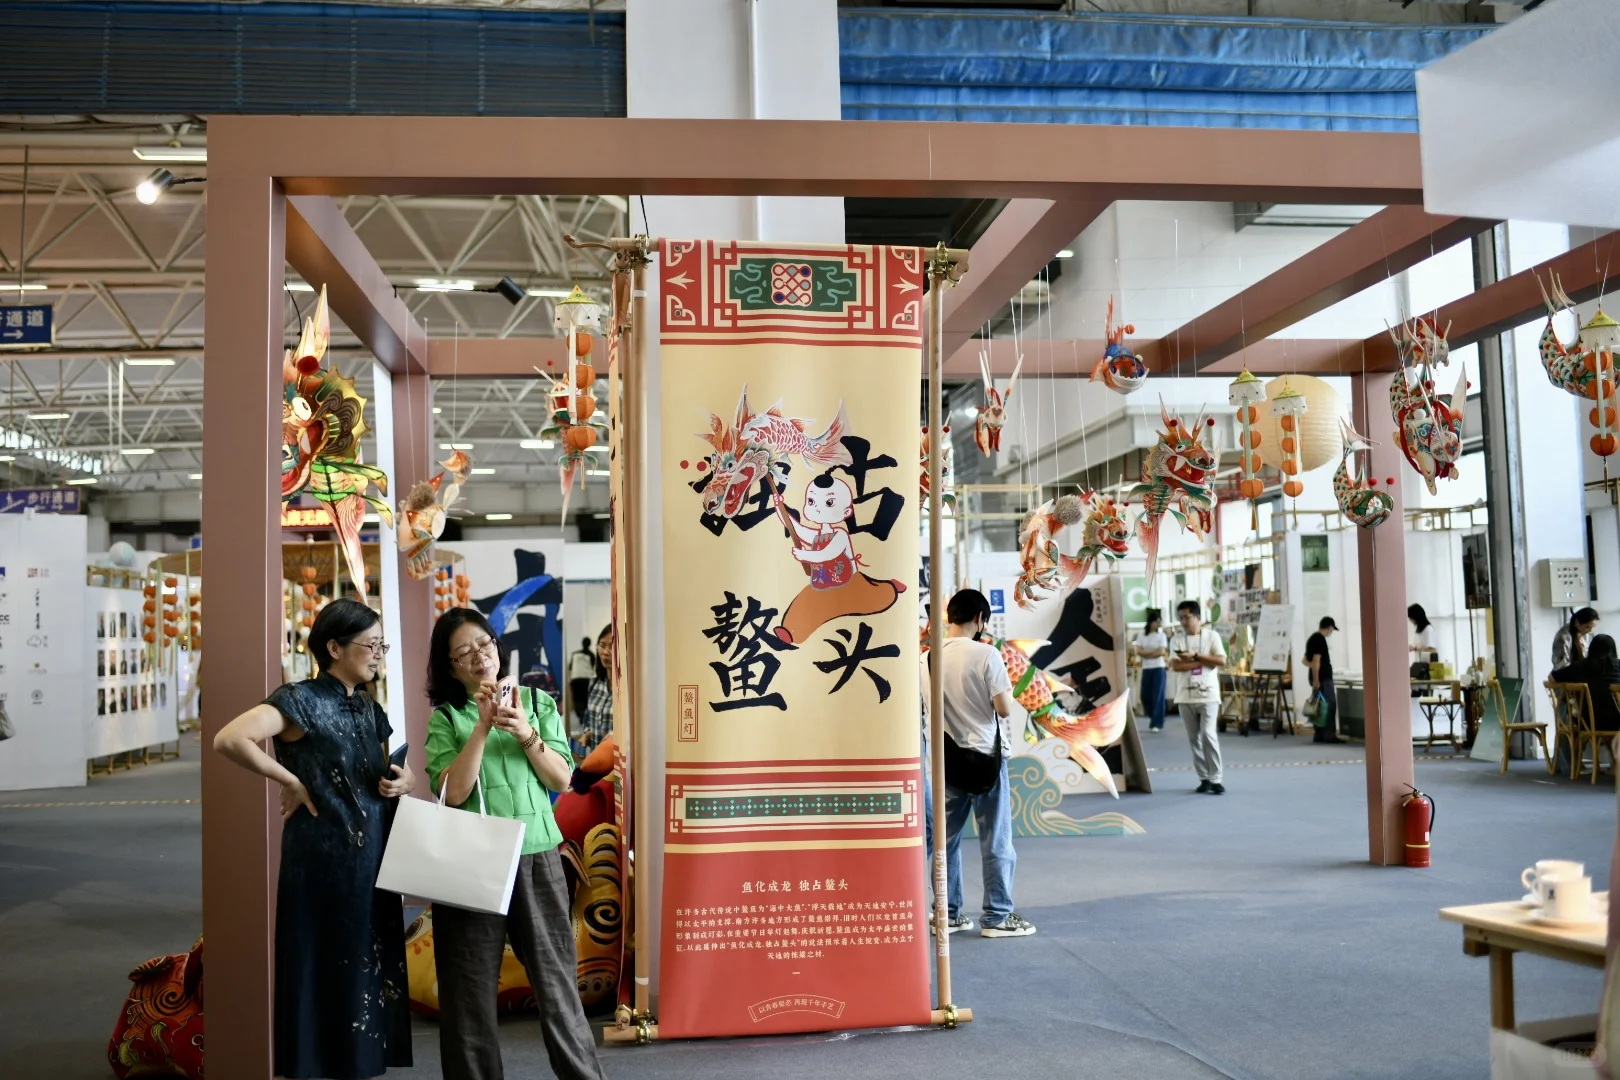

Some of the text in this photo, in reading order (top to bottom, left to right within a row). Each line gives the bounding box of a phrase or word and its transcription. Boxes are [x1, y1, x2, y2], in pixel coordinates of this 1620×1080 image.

[27, 490, 76, 505] 步行通道
[702, 591, 901, 712] 鳌头
[683, 691, 694, 735] 鳌鱼灯
[741, 878, 849, 893] 鱼化成龙 独占鳌头
